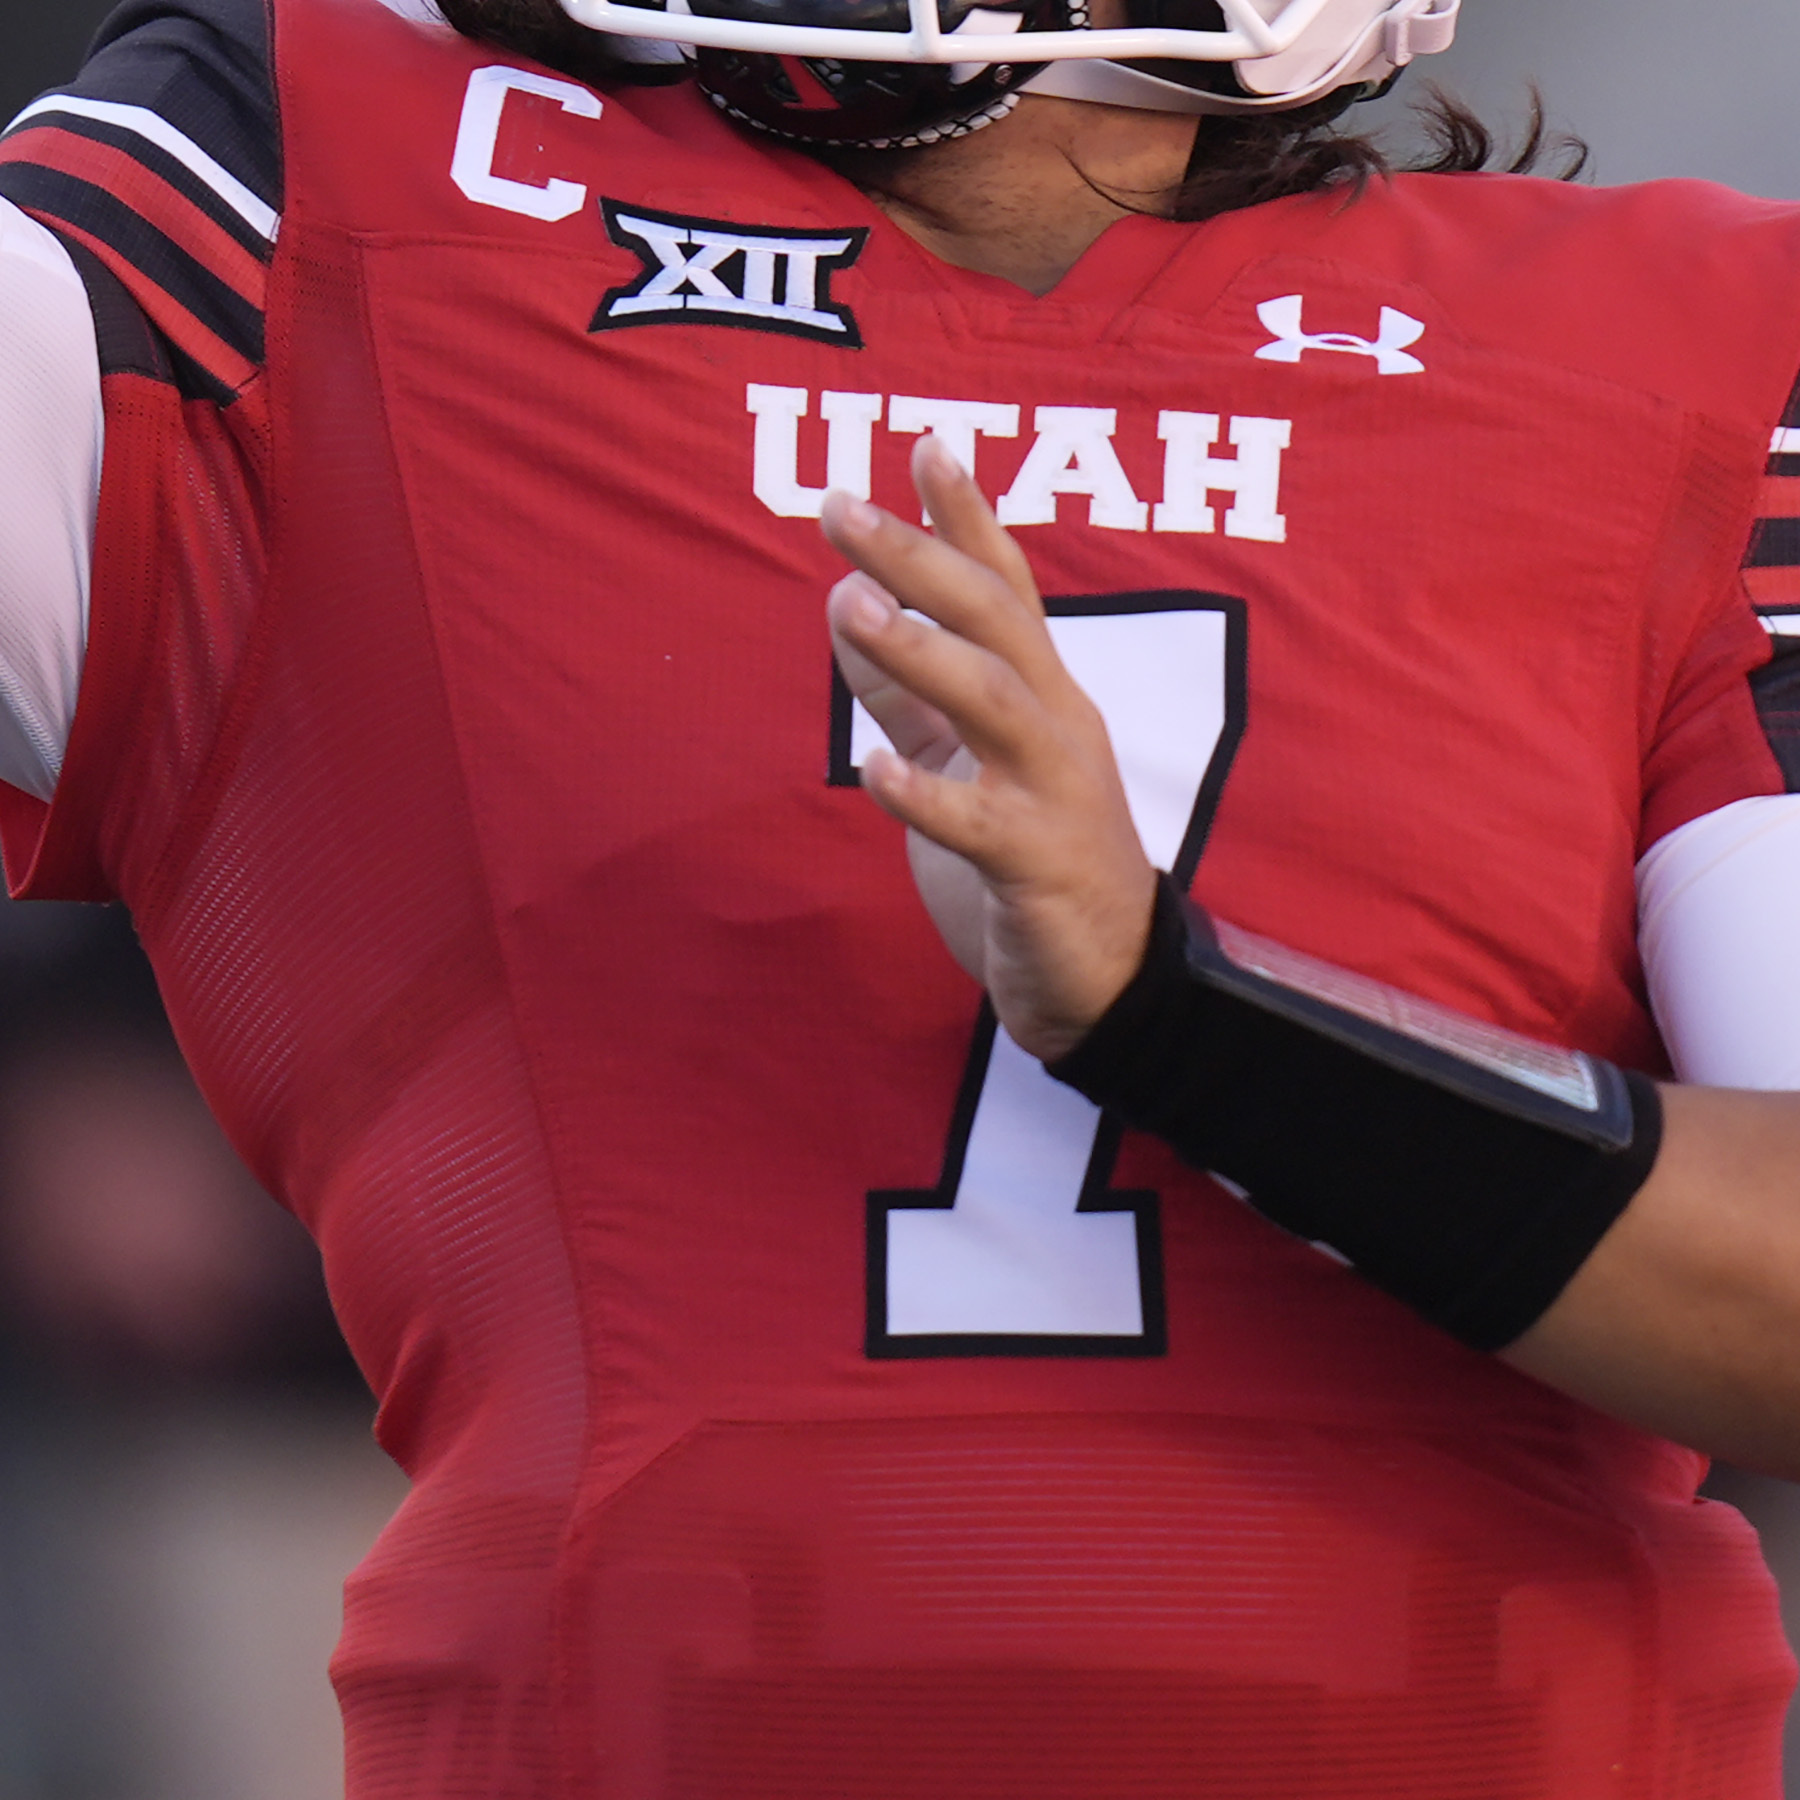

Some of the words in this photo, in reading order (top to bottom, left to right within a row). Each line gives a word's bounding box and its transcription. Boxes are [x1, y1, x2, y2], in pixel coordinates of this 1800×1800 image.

[450, 65, 602, 221] C
[608, 212, 853, 332] XII
[746, 383, 1292, 542] UTAH
[827, 589, 1248, 1360] 7
